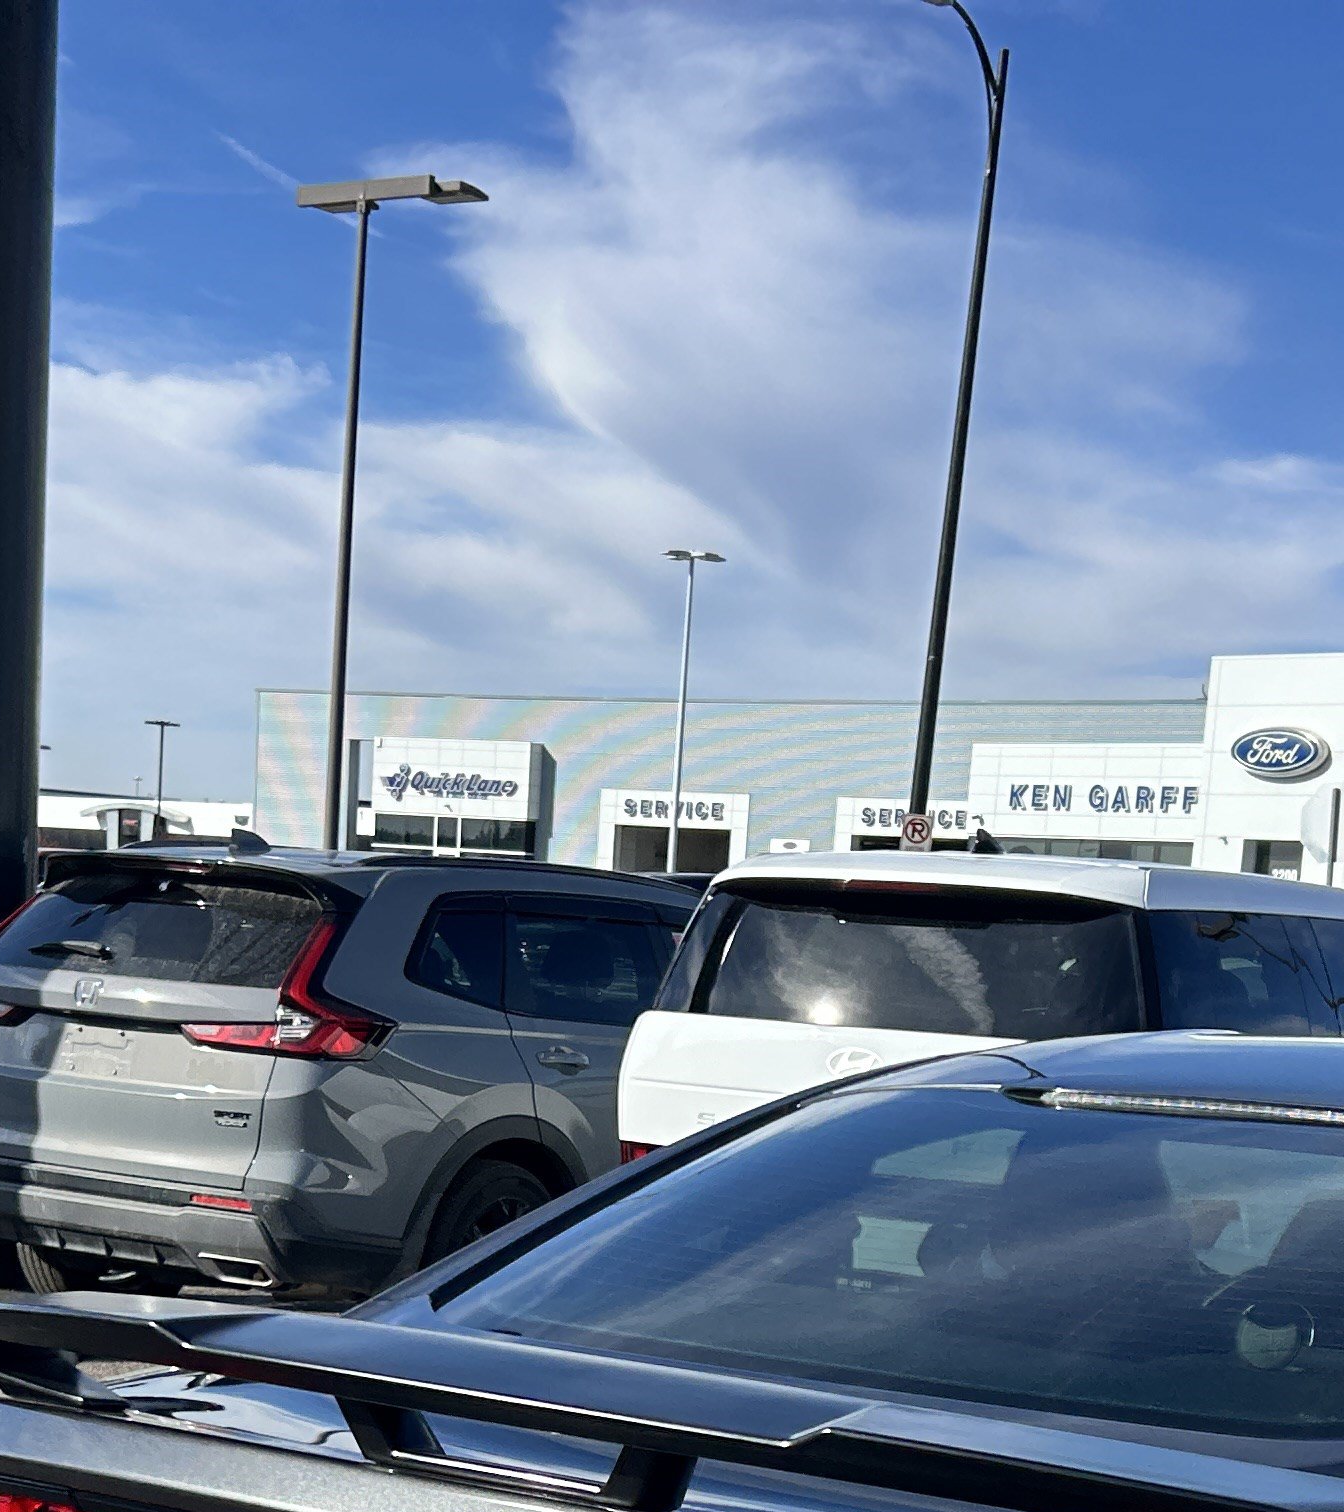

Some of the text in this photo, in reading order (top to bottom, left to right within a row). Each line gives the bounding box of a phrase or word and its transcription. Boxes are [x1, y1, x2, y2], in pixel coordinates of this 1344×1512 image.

[1247, 736, 1299, 764] Ford
[411, 770, 466, 794] Quick
[465, 774, 518, 797] Lane
[624, 799, 725, 821] SERVICE
[1009, 784, 1200, 814] KEN GARFF
